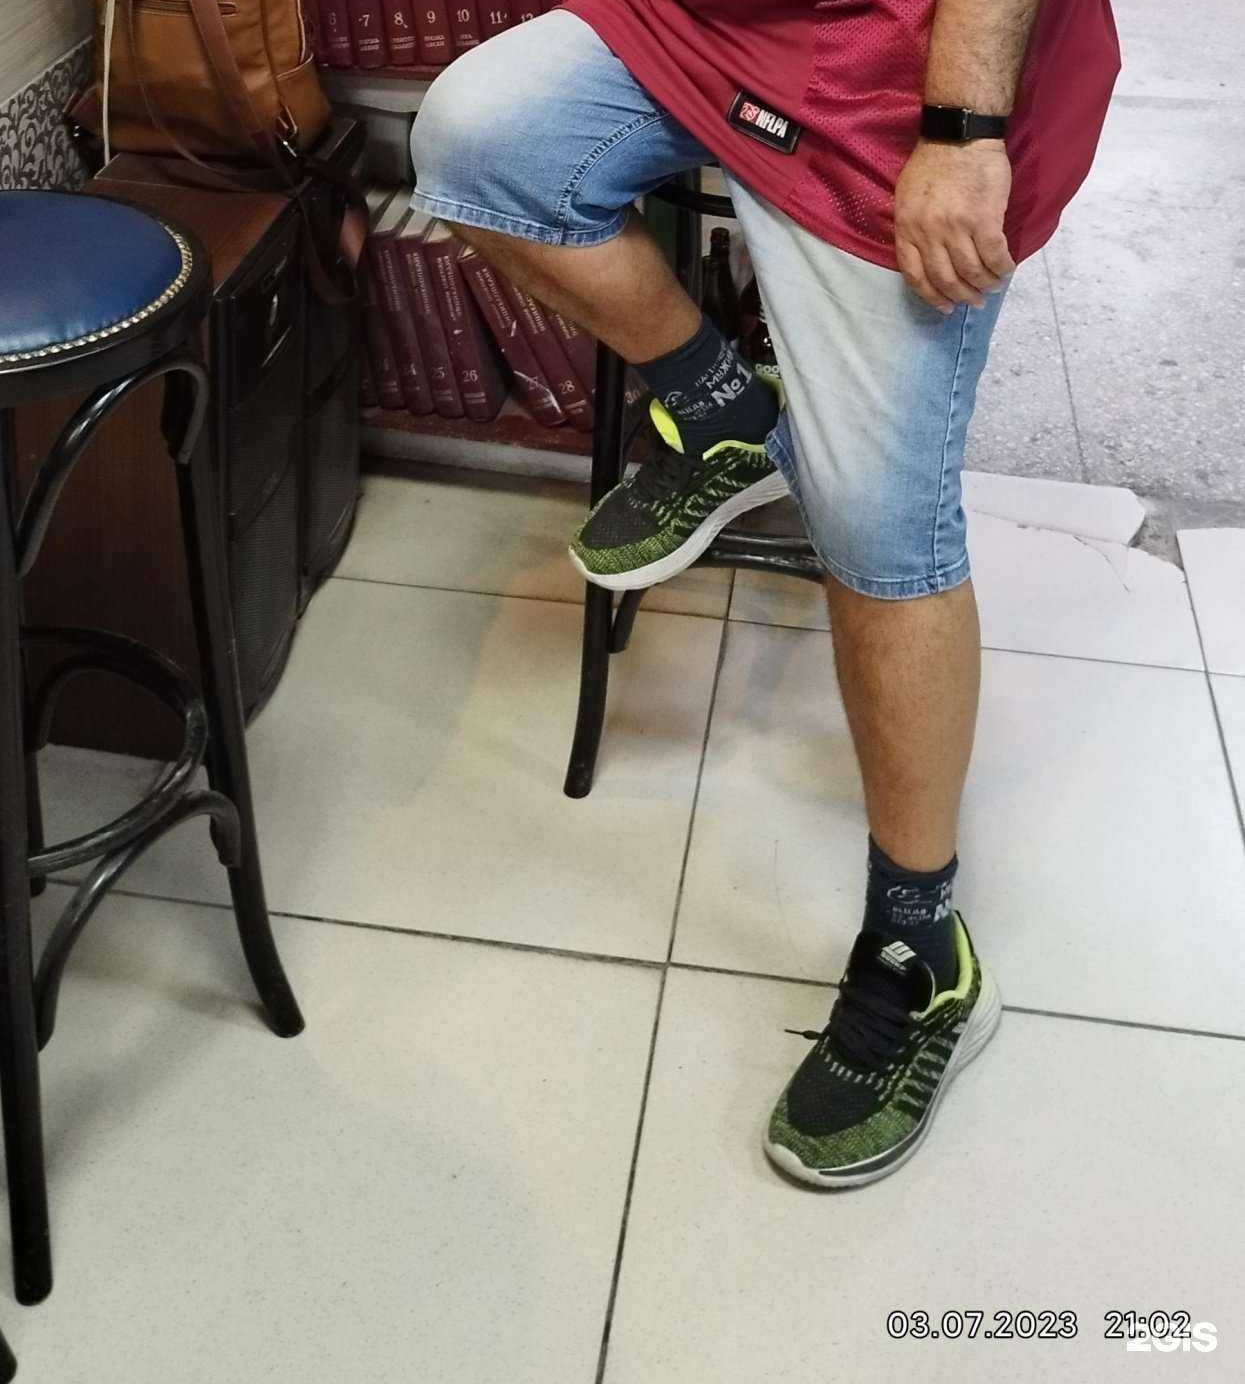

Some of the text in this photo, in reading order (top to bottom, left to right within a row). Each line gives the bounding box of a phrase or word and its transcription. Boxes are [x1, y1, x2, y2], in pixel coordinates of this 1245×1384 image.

[395, 12, 404, 26] 8
[427, 10, 436, 24] 9
[457, 8, 470, 23] 10
[490, 10, 503, 25] 11
[756, 109, 789, 138] NFLPA
[464, 368, 479, 384] 26
[560, 379, 576, 395] 28
